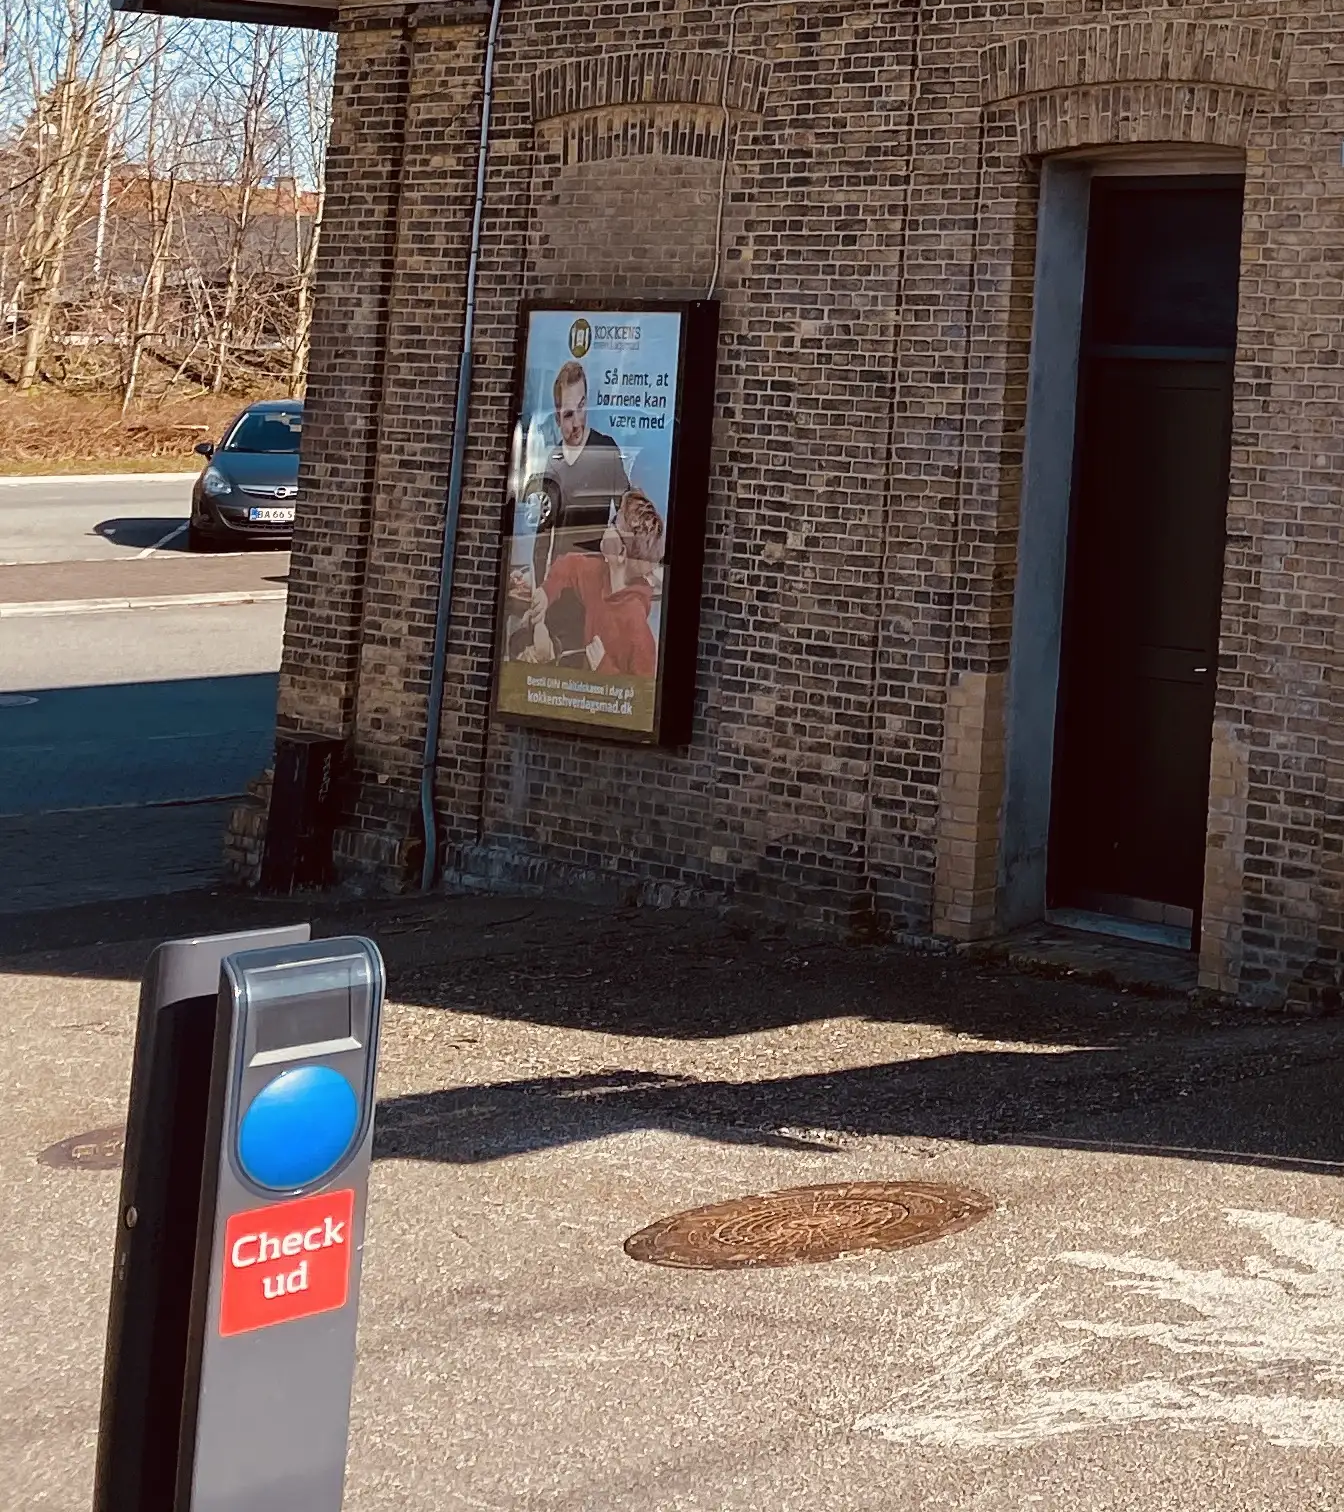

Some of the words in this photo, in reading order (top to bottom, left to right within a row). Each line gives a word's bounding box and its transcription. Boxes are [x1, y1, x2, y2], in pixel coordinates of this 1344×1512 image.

[604, 367, 618, 385] Så
[622, 372, 652, 388] nemt,
[656, 372, 669, 387] at
[596, 389, 641, 407] børnene
[644, 391, 667, 408] kan
[609, 415, 636, 429] være
[638, 412, 666, 430] med
[231, 1216, 345, 1268] Check
[262, 1259, 309, 1300] ud
